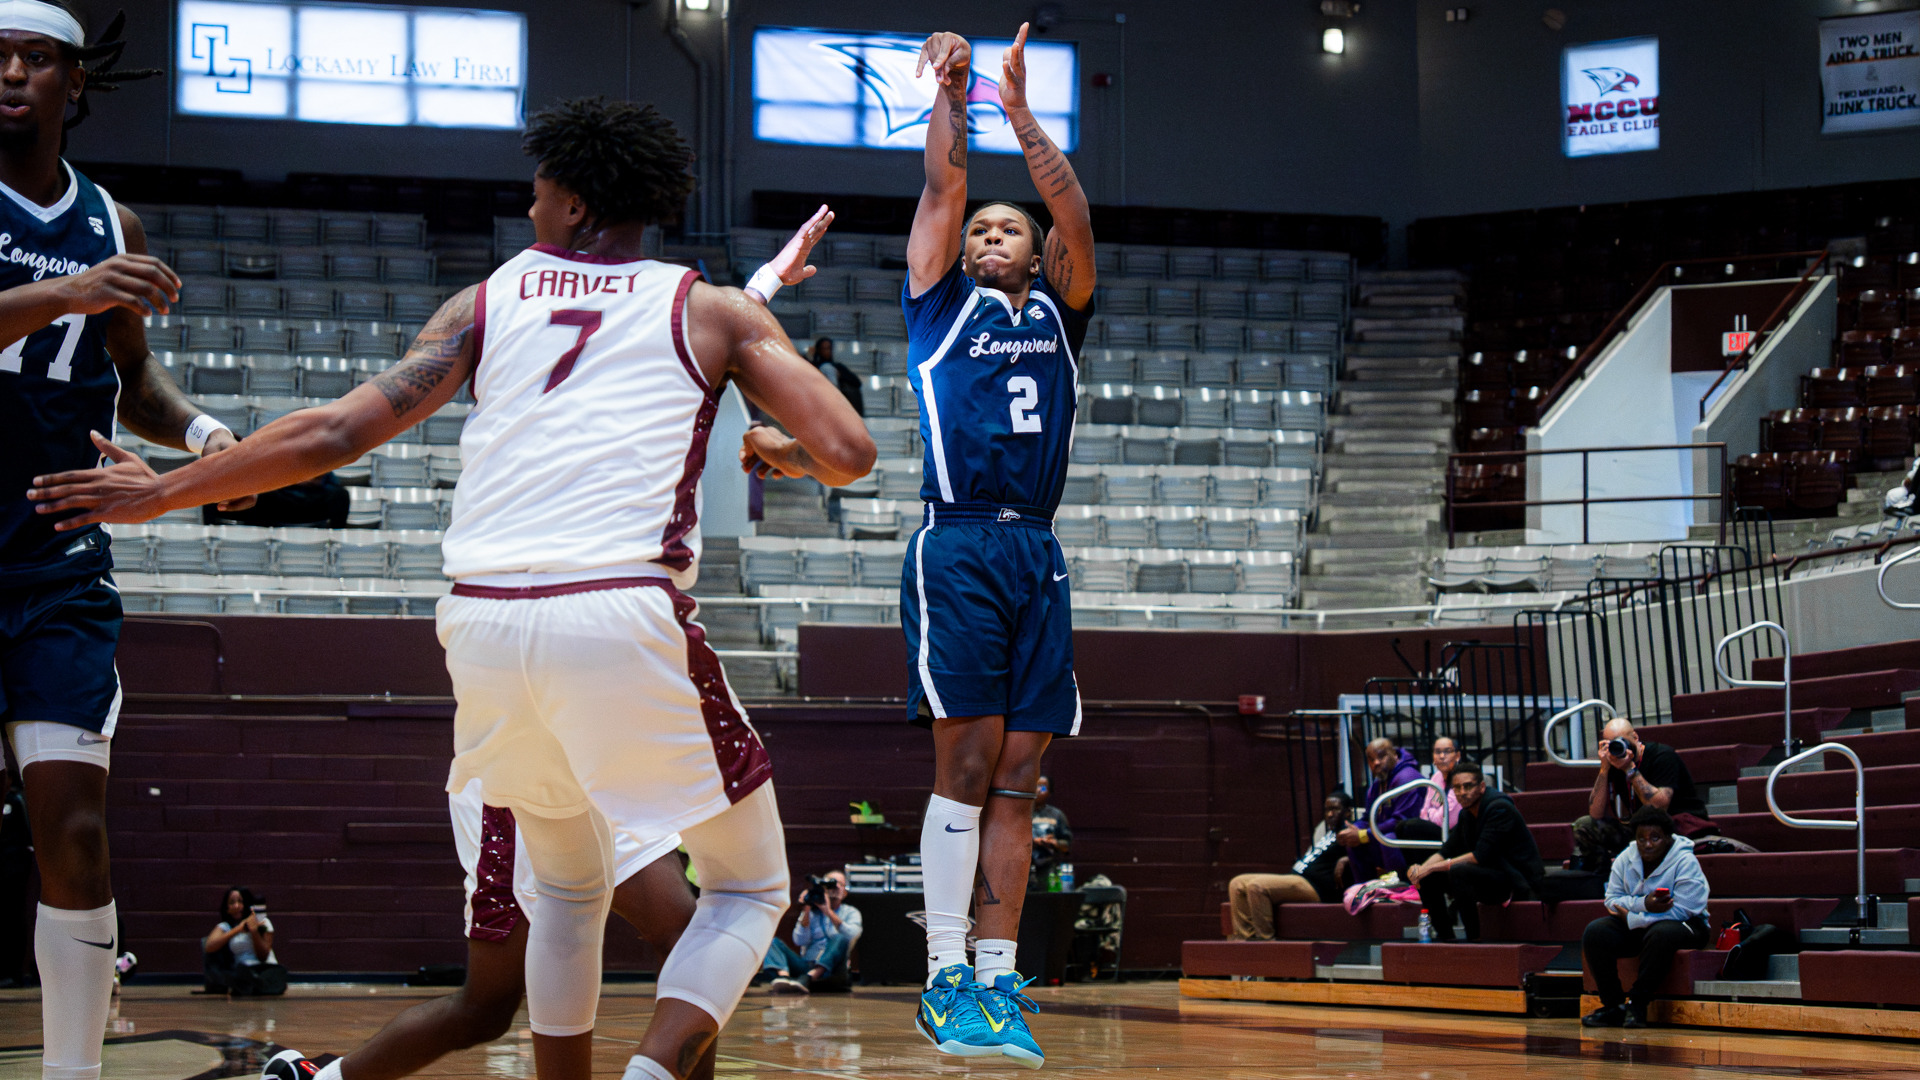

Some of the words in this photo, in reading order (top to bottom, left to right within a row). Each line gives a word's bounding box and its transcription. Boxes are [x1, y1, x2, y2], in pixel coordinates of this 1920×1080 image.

[1839, 35, 1869, 48] TWO
[1874, 31, 1902, 45] MEN
[1827, 51, 1855, 64] AND
[1860, 51, 1868, 61] A
[1872, 45, 1914, 59] TRUCK
[1839, 90, 1856, 99] TWO
[1859, 88, 1877, 97] MEN
[1878, 85, 1897, 94] AND
[1899, 85, 1905, 93] A
[1567, 97, 1659, 123] NCCU
[1827, 100, 1864, 115] JUNK
[1868, 94, 1917, 111] TRUCK
[1567, 122, 1618, 136] EAGLE
[0, 233, 90, 281] Longwoo
[520, 270, 644, 300] CARVEY
[540, 308, 604, 395] 7
[969, 332, 1058, 363] Longwood
[1728, 332, 1750, 352] EXIT
[1007, 376, 1042, 433] 2
